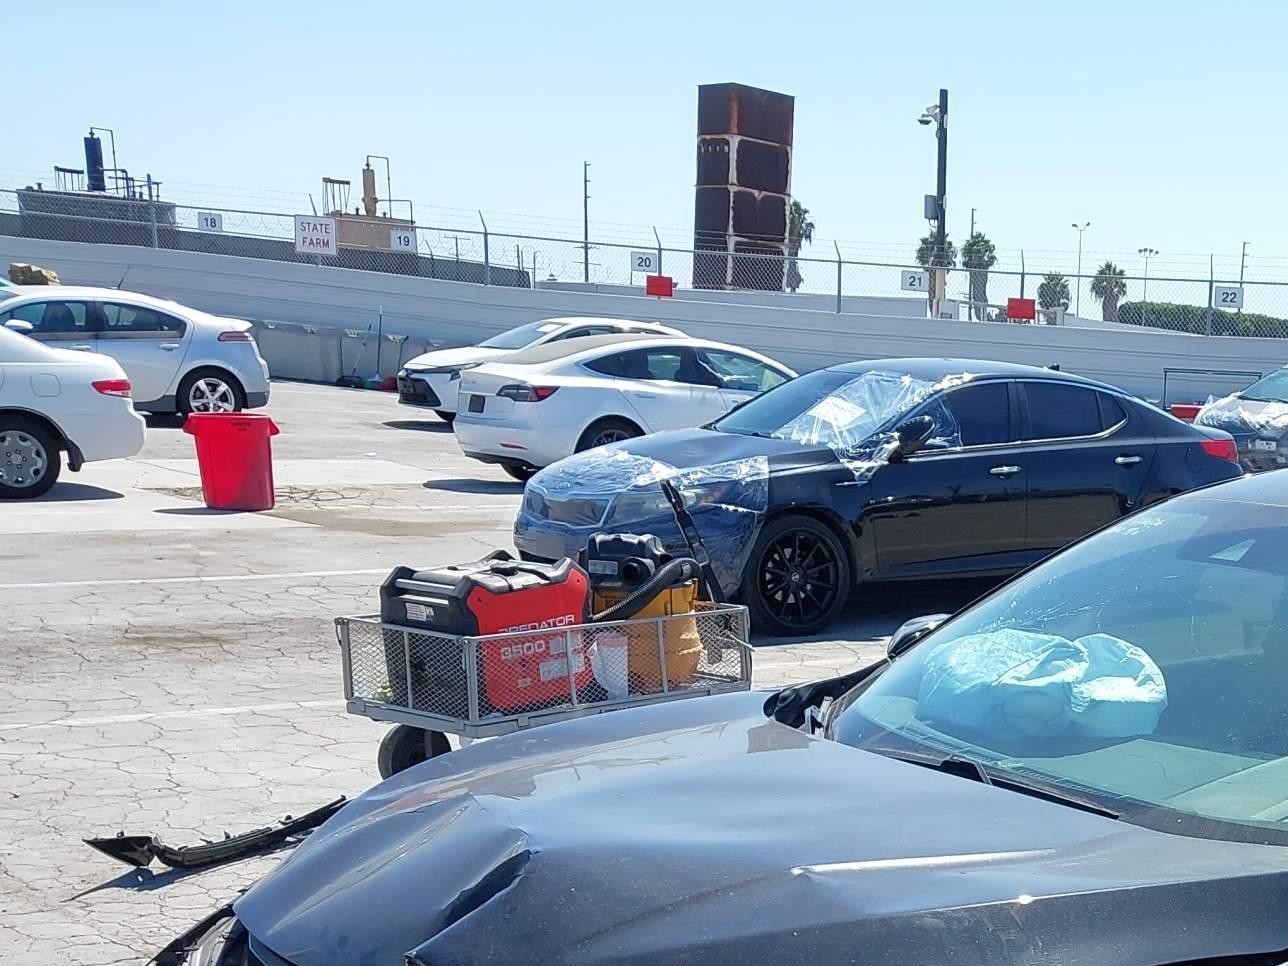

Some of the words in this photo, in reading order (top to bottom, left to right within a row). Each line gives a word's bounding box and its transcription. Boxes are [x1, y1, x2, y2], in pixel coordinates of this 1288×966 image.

[204, 217, 217, 229] 18
[300, 221, 331, 234] STATE
[302, 237, 330, 249] FARM
[398, 235, 410, 247] 19
[637, 257, 651, 268] 20
[908, 275, 922, 288] 21
[1222, 291, 1237, 303] 22
